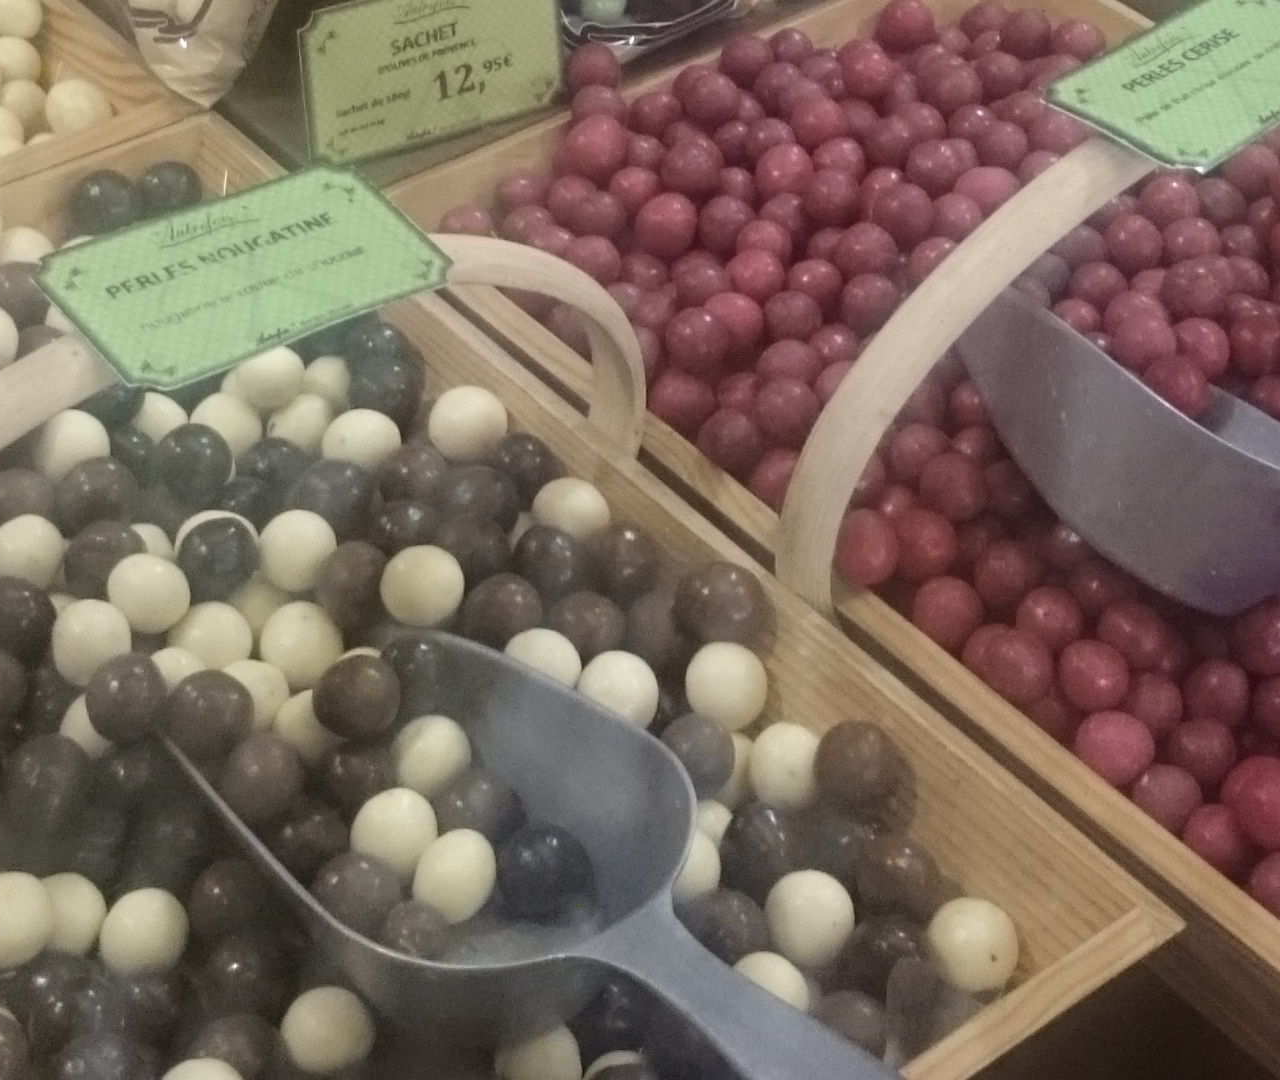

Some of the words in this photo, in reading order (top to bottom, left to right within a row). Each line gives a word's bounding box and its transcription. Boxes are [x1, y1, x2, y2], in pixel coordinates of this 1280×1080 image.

[390, 21, 459, 56] SACHET
[1121, 58, 1186, 94] PERLES
[1181, 28, 1241, 62] CERISE
[104, 258, 198, 299] PERLES
[196, 211, 335, 266] NOUGATINE
